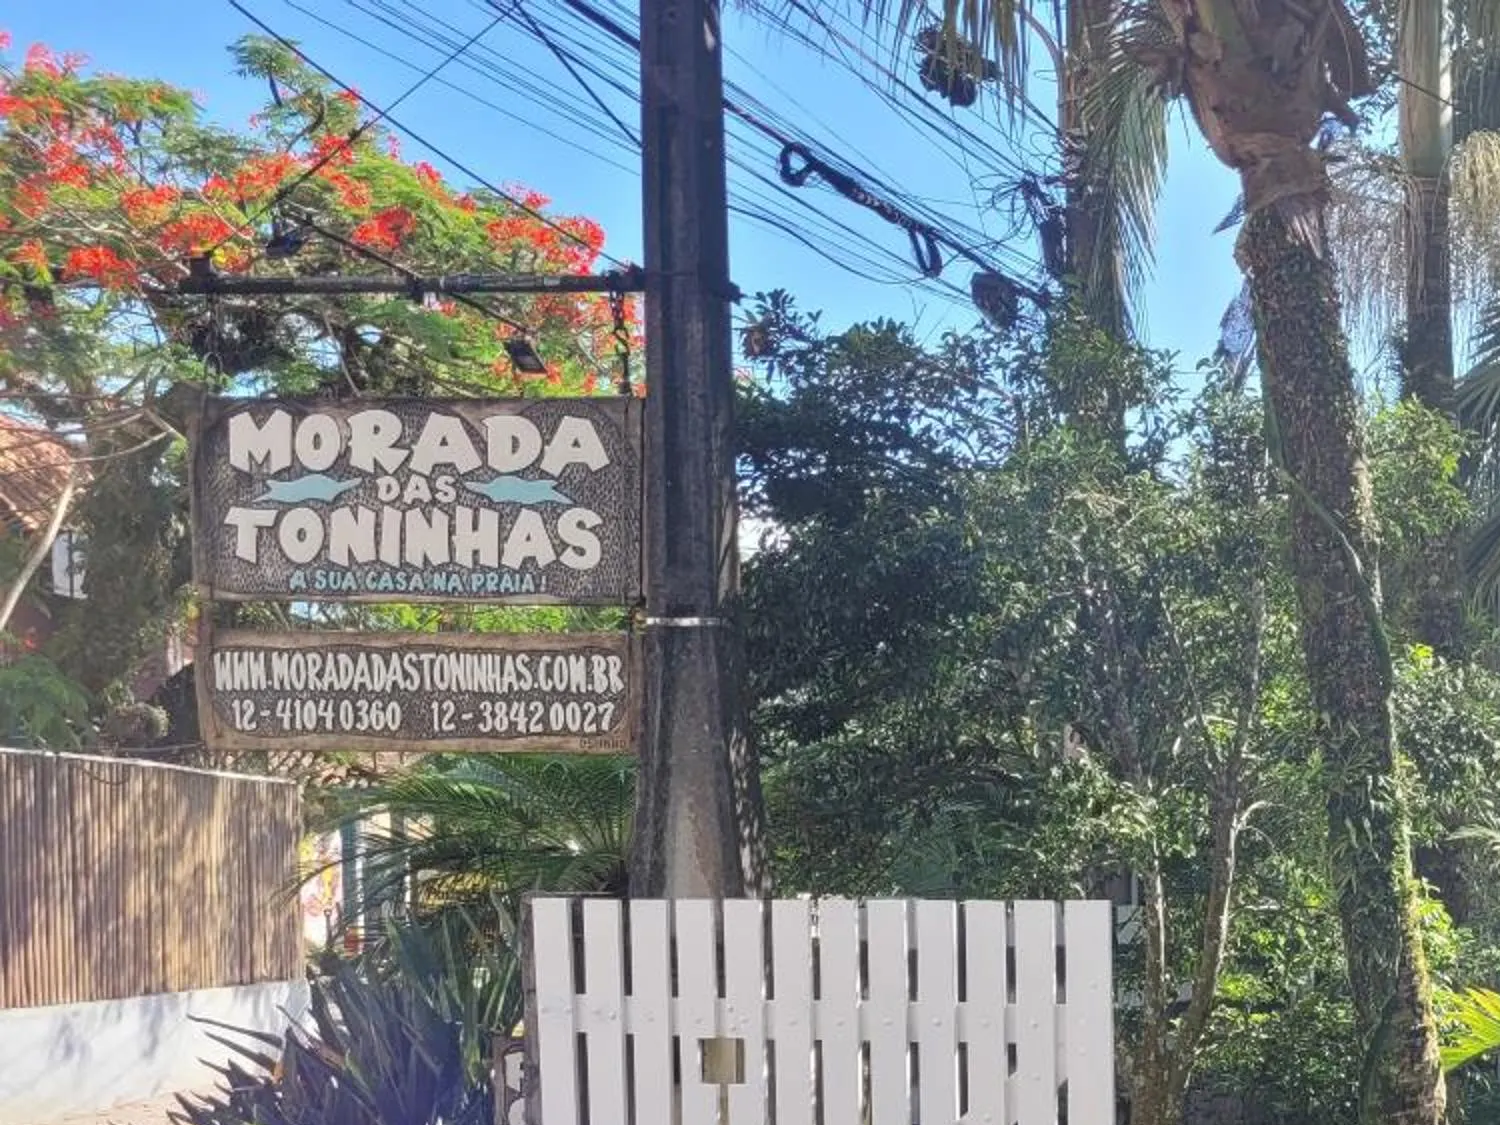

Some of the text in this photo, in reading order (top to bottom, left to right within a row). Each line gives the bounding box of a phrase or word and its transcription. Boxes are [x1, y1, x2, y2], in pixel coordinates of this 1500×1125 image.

[228, 409, 610, 475] MORADA
[376, 475, 457, 503] DAS
[224, 504, 601, 569] TONINHAS
[289, 570, 305, 590] A
[314, 570, 358, 592] SUA
[364, 571, 425, 592] CASA
[431, 572, 464, 593] NA
[213, 651, 625, 694] WWW.MORADADASTONINHAS.COM.BR
